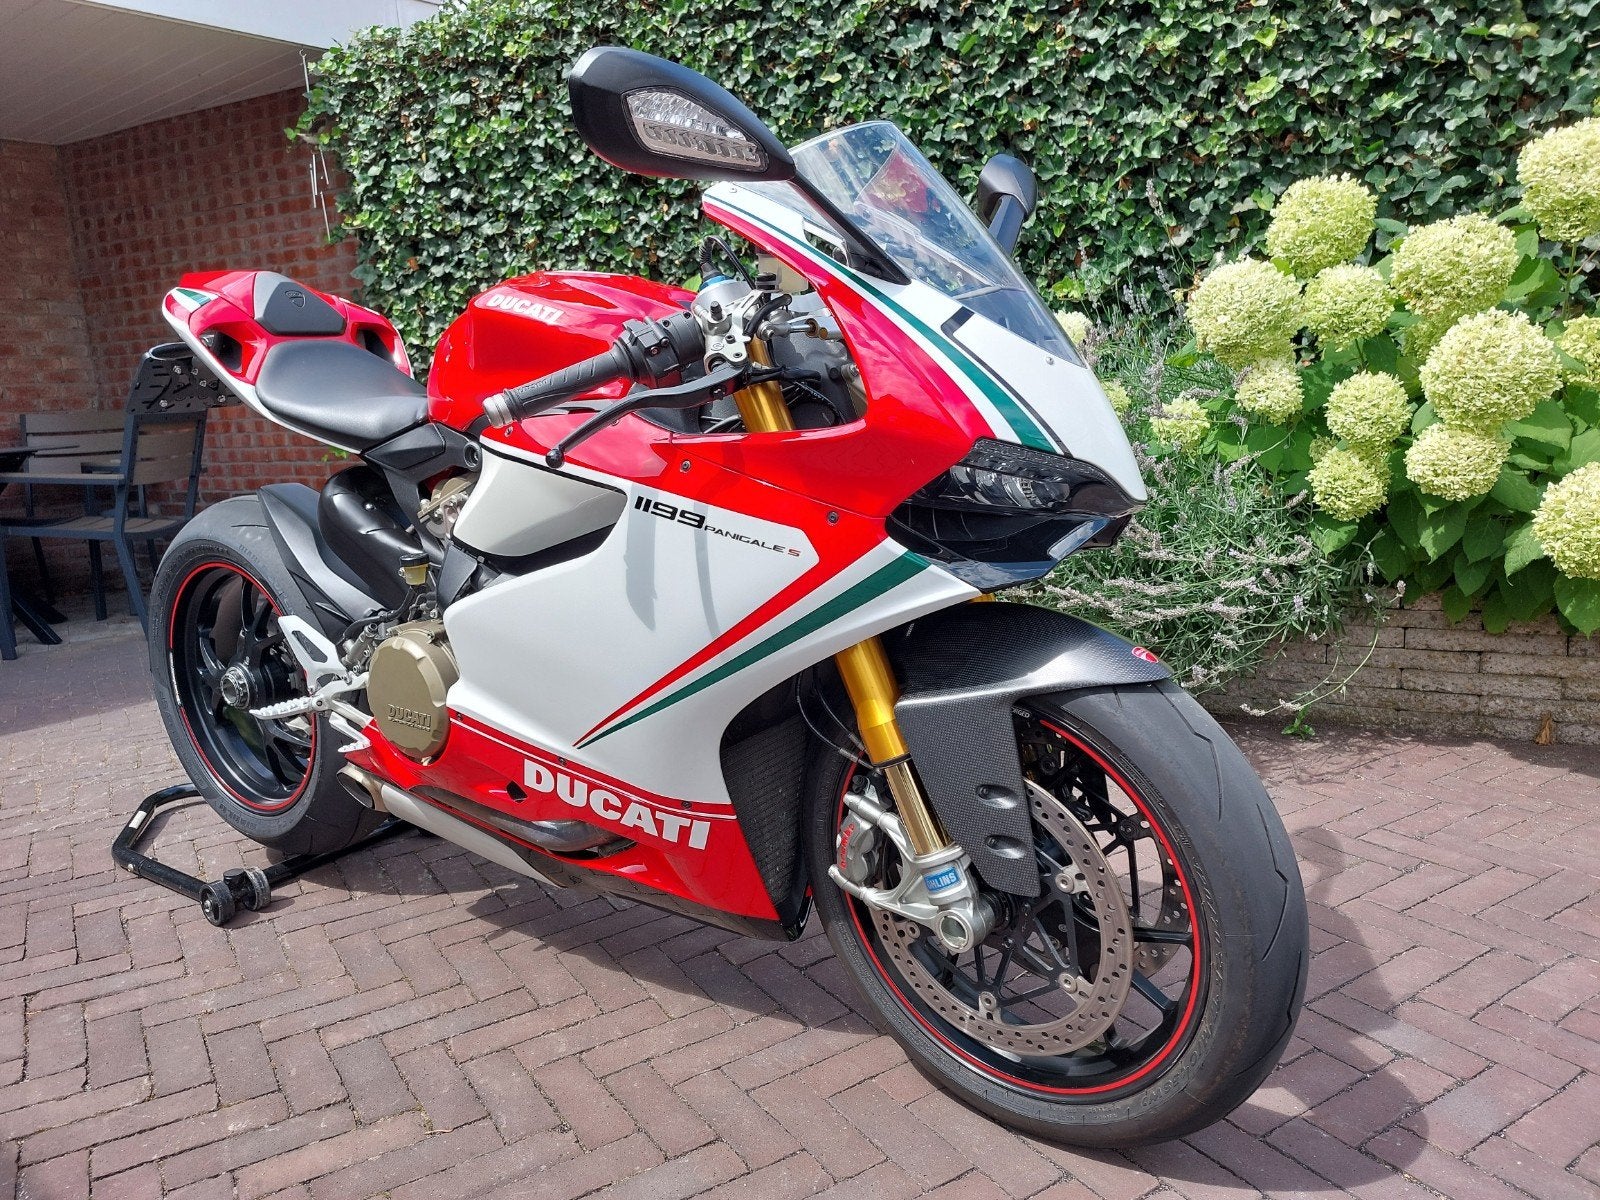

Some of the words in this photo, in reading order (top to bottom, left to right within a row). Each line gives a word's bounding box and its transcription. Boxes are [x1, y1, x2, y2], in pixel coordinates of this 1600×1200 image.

[485, 293, 565, 323] DUCATI
[634, 495, 706, 530] 1199
[704, 524, 786, 554] PANIGALE
[788, 548, 801, 558] S
[388, 703, 432, 728] DUCATI
[523, 758, 711, 850] DUCATI
